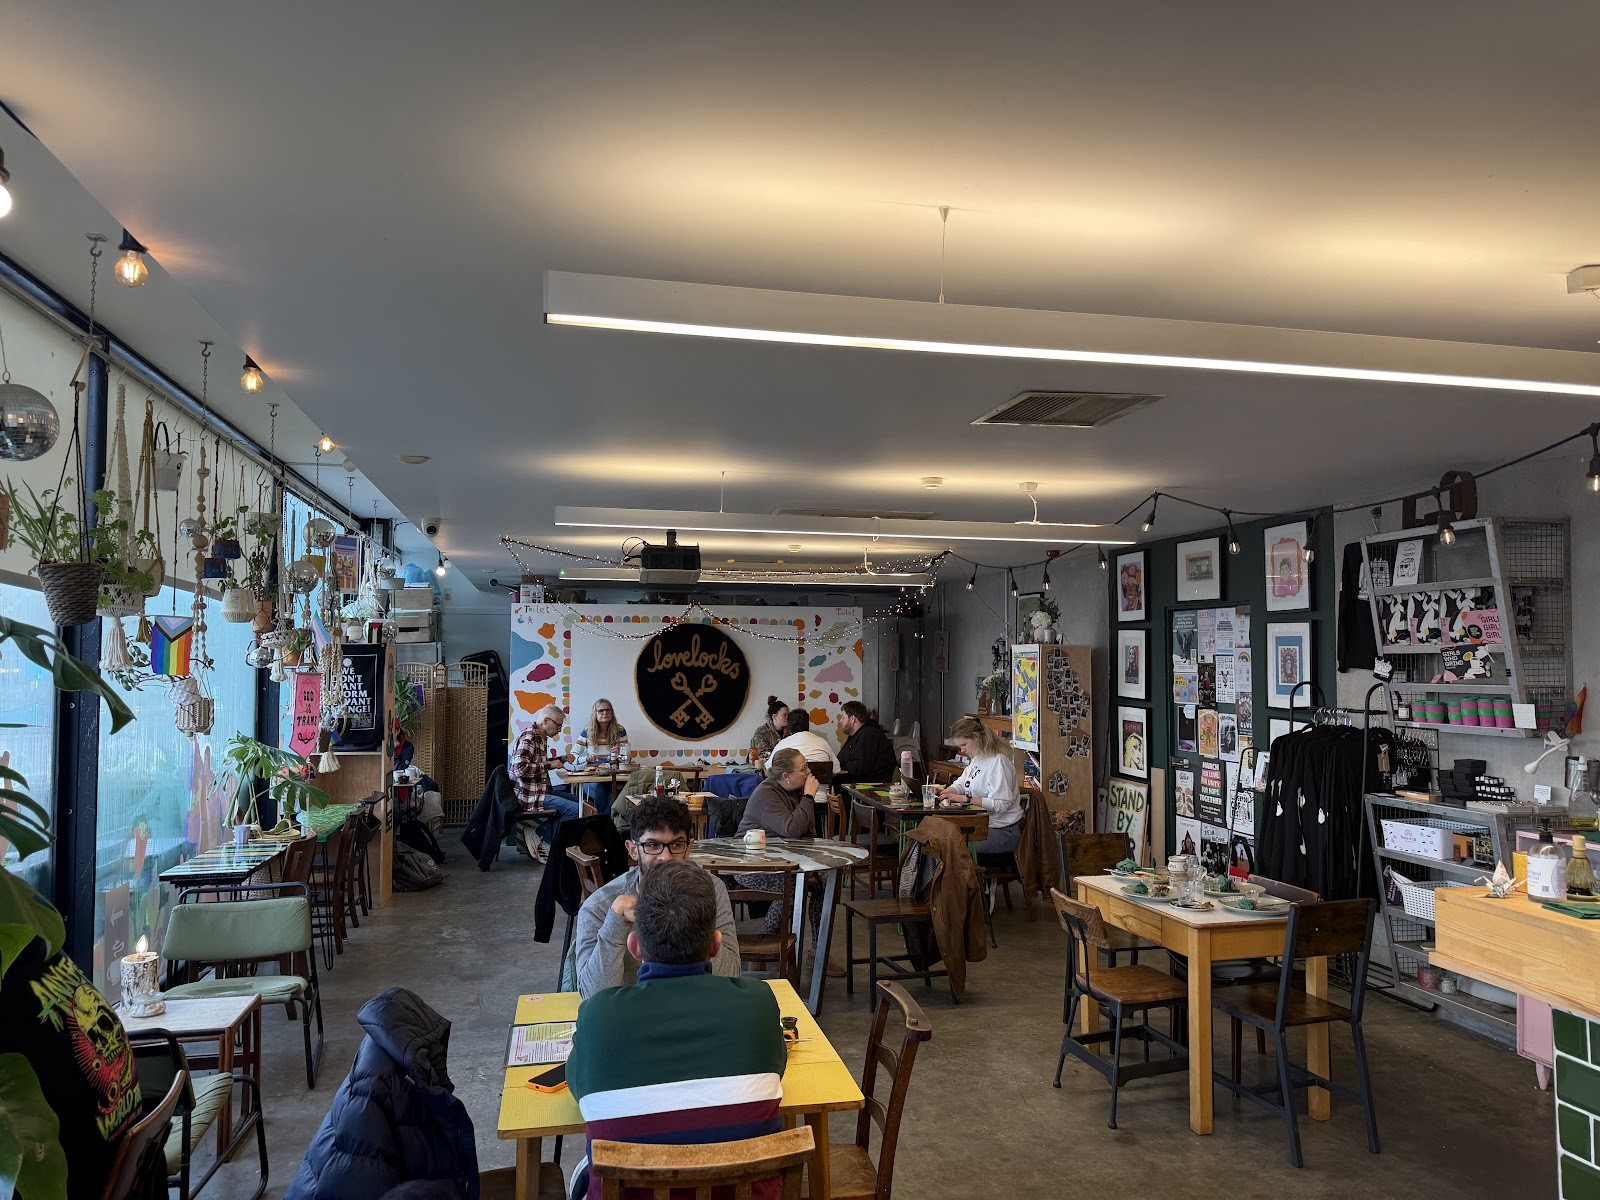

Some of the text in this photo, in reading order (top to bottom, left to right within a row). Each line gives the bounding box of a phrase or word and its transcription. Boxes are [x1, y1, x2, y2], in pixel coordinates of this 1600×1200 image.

[524, 605, 550, 613] Toilet
[835, 607, 856, 616] Toilet
[1483, 623, 1501, 631] GIRL
[646, 633, 740, 680] lovelocks
[1202, 761, 1220, 771] MARCH
[1110, 785, 1144, 812] STAND
[1199, 793, 1223, 806] TOGETHER
[1117, 810, 1134, 833] BY
